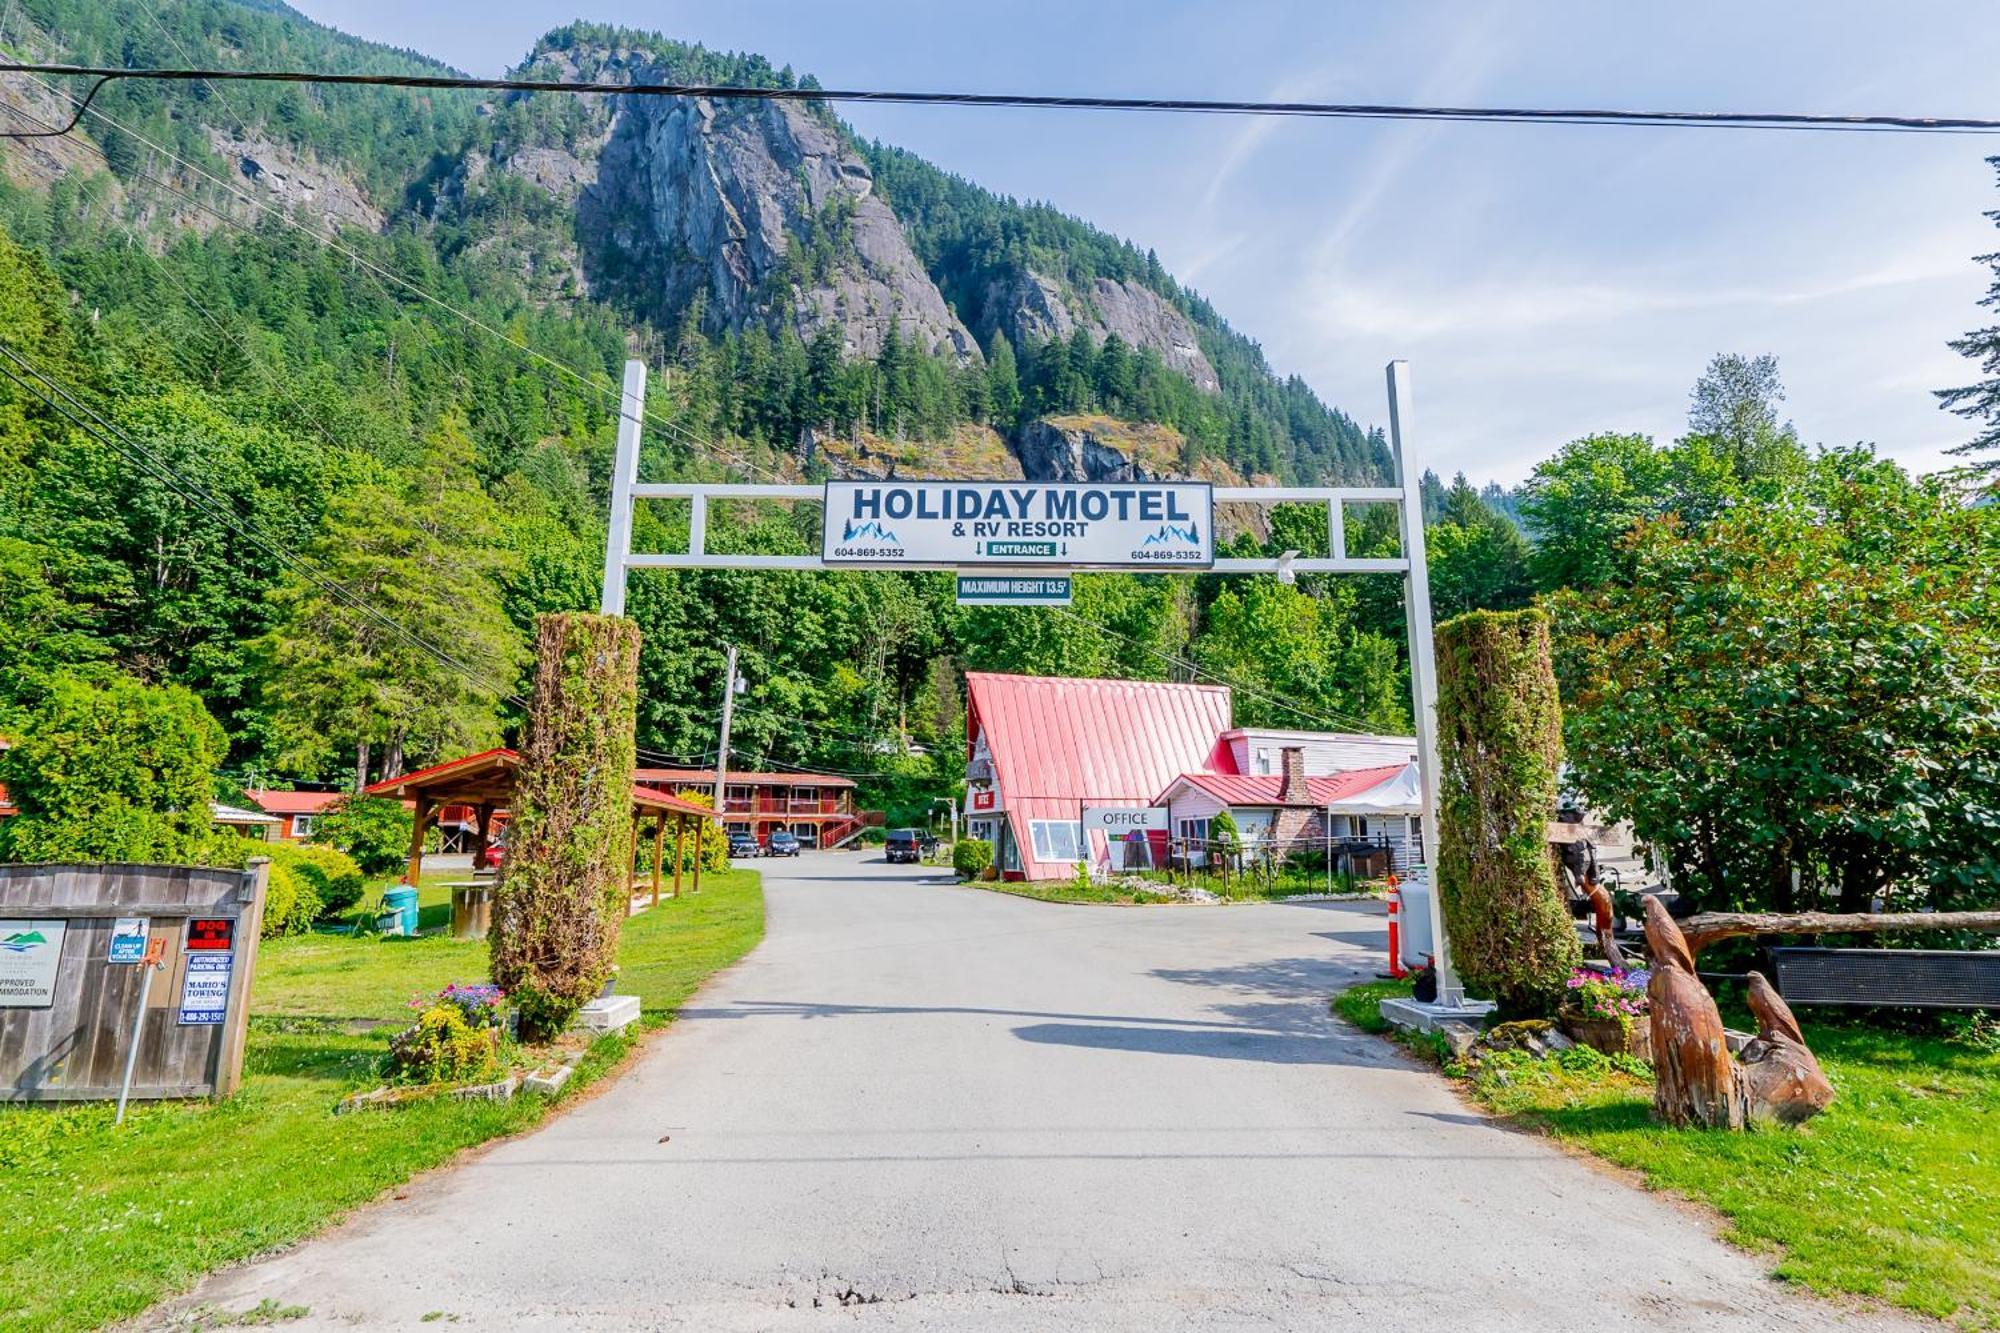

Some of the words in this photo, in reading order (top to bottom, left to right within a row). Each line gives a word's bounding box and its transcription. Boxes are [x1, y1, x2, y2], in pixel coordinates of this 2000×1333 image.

[853, 488, 1038, 520] HOLIDAY
[1045, 489, 1190, 521] MOTEL
[952, 522, 966, 537] &
[974, 522, 1001, 537] RV
[1007, 522, 1089, 537] RESORT
[834, 548, 905, 558] 604-869-5352
[991, 545, 1051, 555] ENTRANCE
[1131, 550, 1202, 560] 604-869-5352
[961, 581, 1010, 594] MAXIMUM
[1011, 581, 1045, 594] HEIGHT
[1103, 812, 1149, 825] OFFICE
[196, 921, 226, 931] DOG
[188, 981, 226, 989] MARIO'S
[187, 989, 224, 997] TOWING
